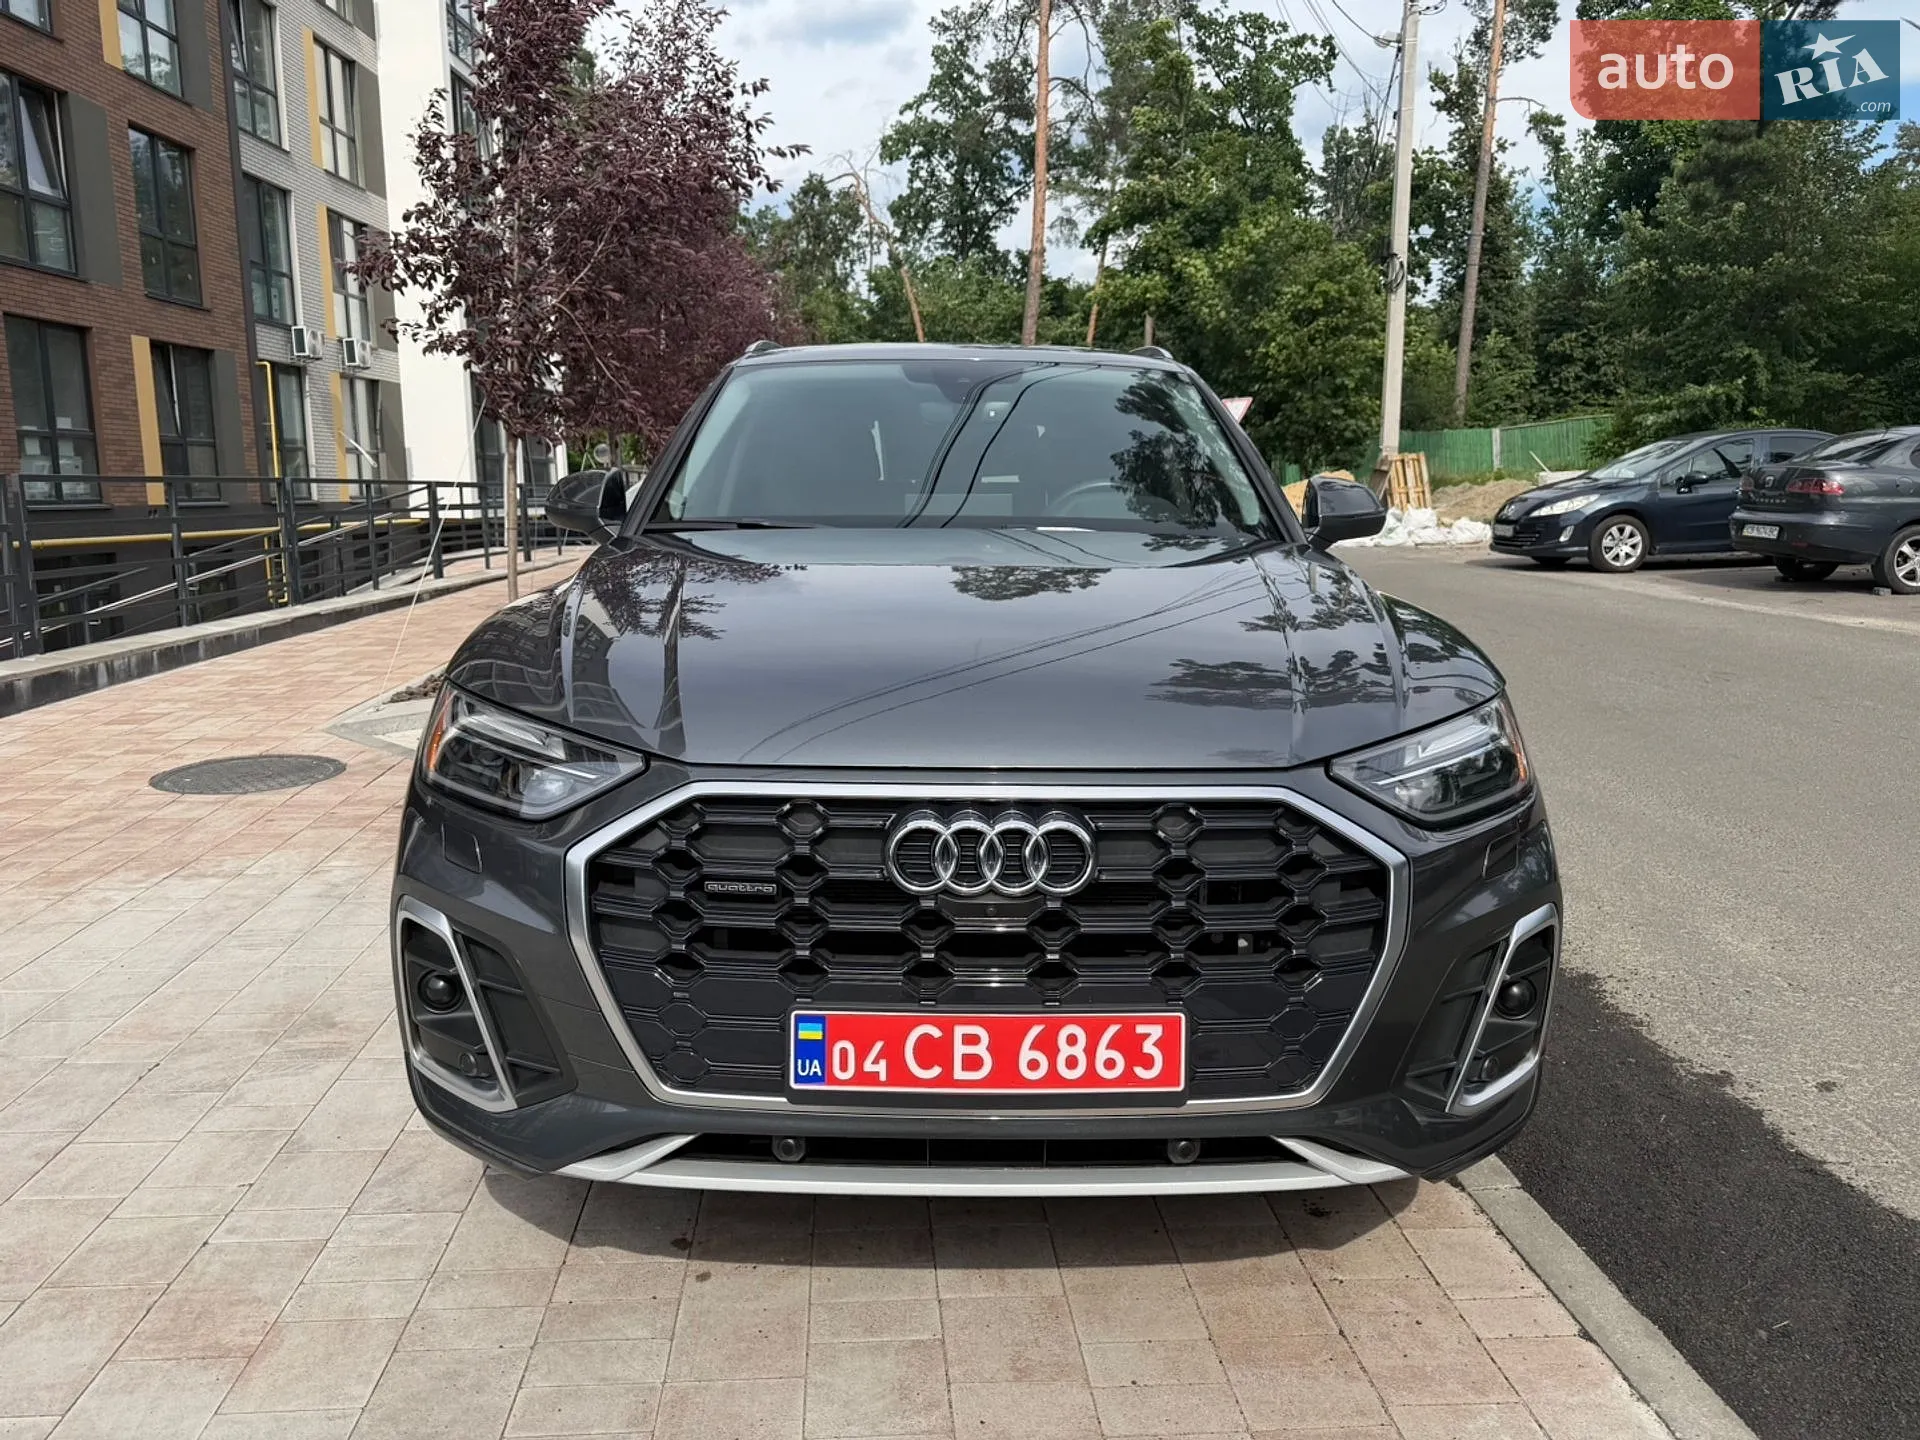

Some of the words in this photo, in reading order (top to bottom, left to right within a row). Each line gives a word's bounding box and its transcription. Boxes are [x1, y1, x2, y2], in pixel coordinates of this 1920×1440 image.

[707, 883, 773, 895] quattro
[832, 1040, 888, 1082] 04
[903, 1023, 994, 1081] CB
[1018, 1023, 1164, 1081] 6863
[797, 1059, 822, 1077] UA
